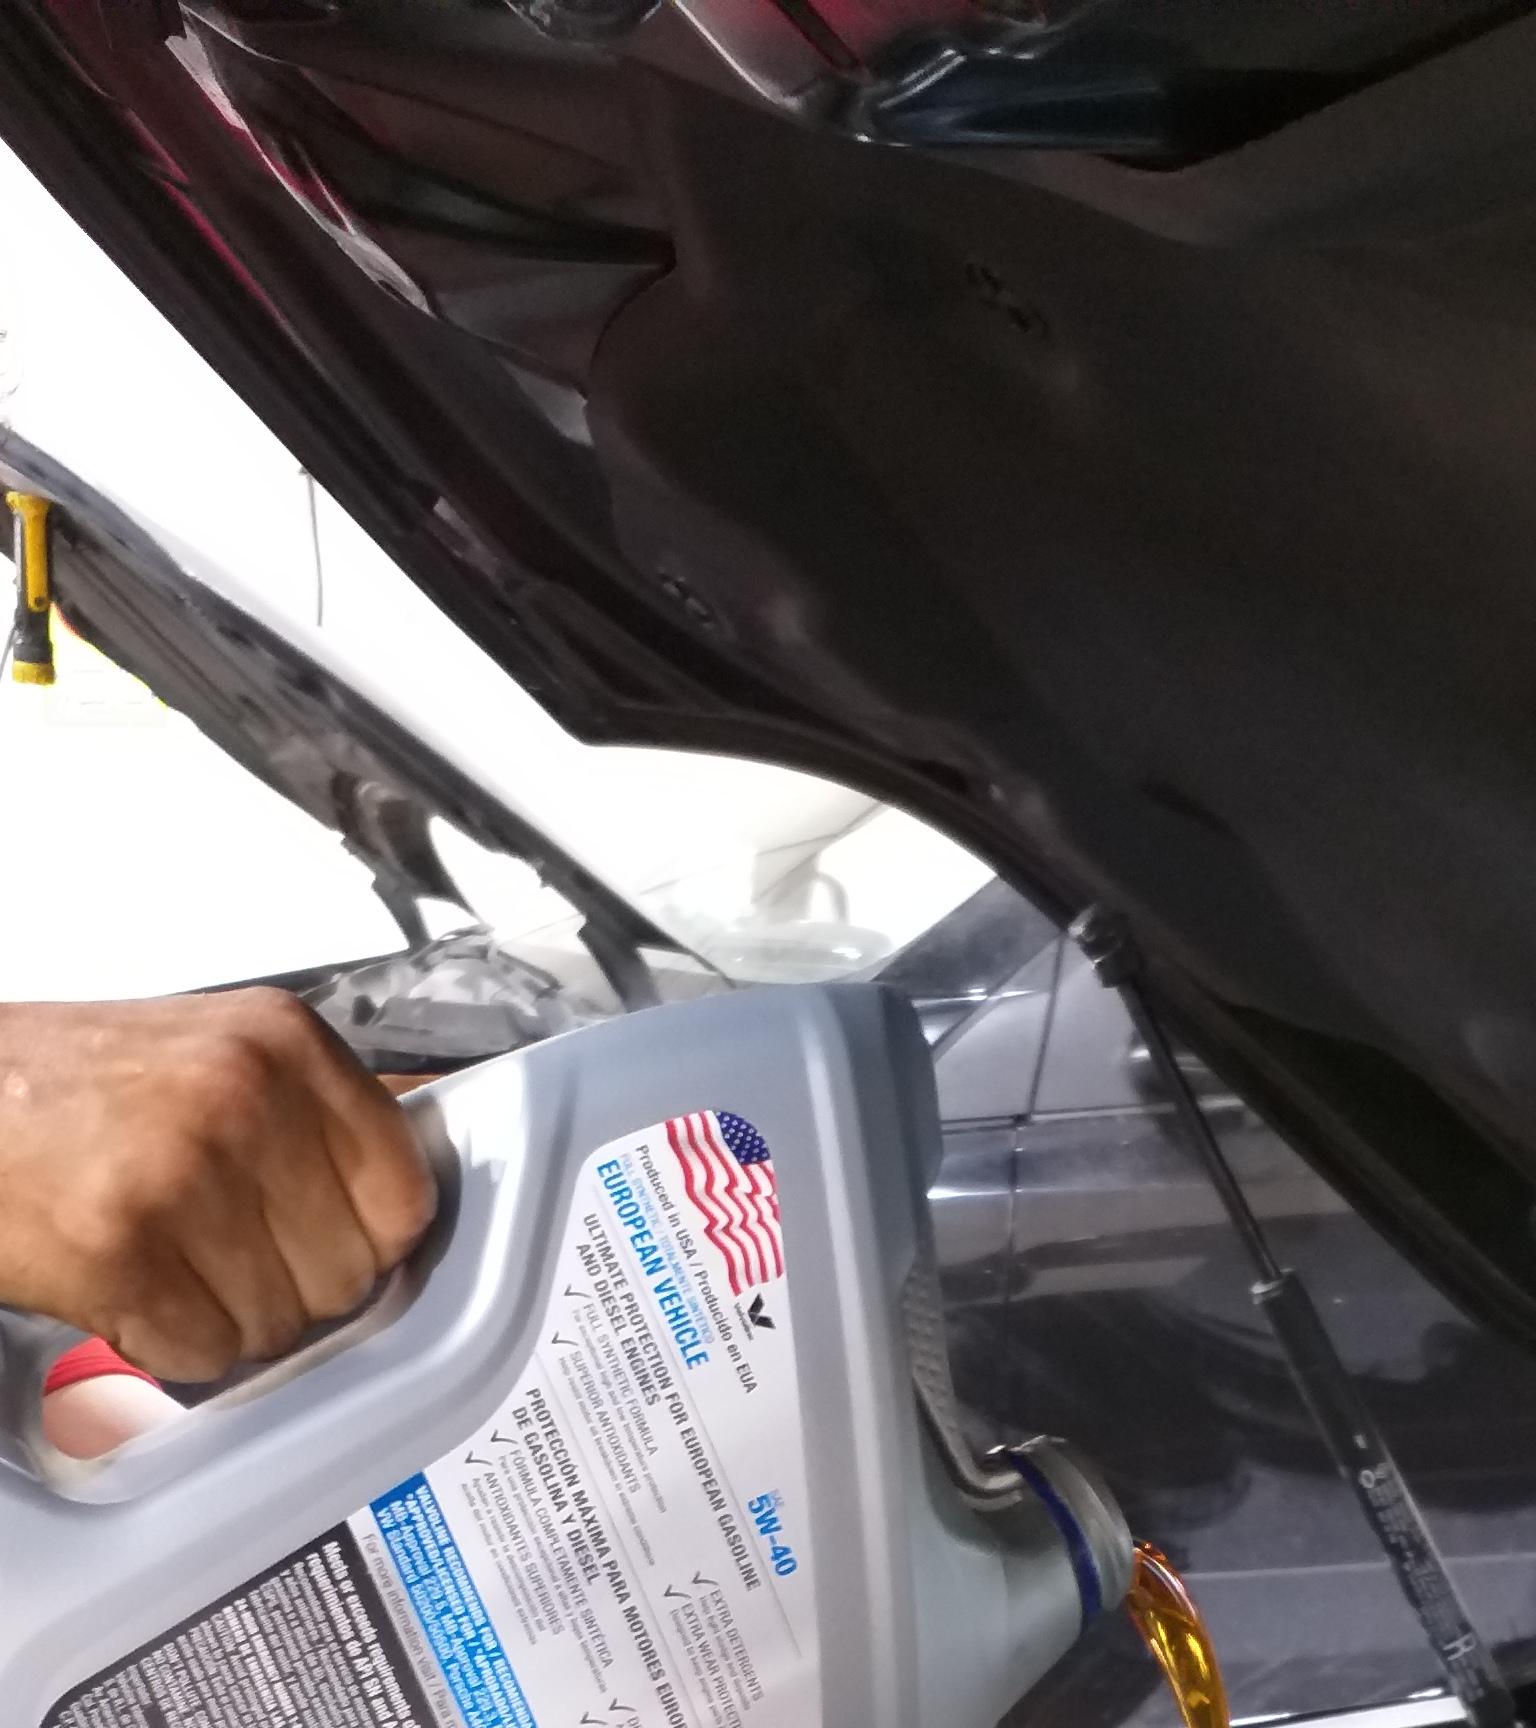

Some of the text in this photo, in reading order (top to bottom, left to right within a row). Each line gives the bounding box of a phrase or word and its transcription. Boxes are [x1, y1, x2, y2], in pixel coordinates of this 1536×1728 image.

[595, 1158, 710, 1371] EUROPEAN VEHICLE
[635, 1144, 759, 1394] Produced in USA / Producido en EUA
[575, 1240, 661, 1407] AND DIESEL ENGINES
[568, 1349, 642, 1494] SUPERIOR ANTIOXIDANTS
[581, 1302, 659, 1456] FULL SYNTHETIC FORMULA
[582, 1211, 762, 1591] ULTIMATE PROTECTION FOR EUROPEAN GASOLINE
[511, 1405, 602, 1585] DE GASOLINA Y DIESEL
[525, 1385, 584, 1488] PROTECCIÓN
[570, 1487, 616, 1559] MÁXIMA
[601, 1559, 632, 1604] PARA
[621, 1604, 666, 1682] MOTORES
[744, 1492, 801, 1579] 5W-40
[304, 1550, 357, 1641] requerimientos
[321, 1539, 352, 1581] Meets
[337, 1577, 358, 1595] or
[414, 1484, 451, 1547] VALVOLINE
[441, 1545, 487, 1627] RECOMMENDS
[477, 1625, 497, 1651] FOR
[508, 1446, 618, 1668] FÓRMULA COMPLETAMENTE SINTÉTICA
[523, 1561, 565, 1636] SUPERIORES
[344, 1592, 380, 1644] exceeds
[344, 1638, 365, 1658] de
[361, 1532, 381, 1556] For
[371, 1555, 396, 1589] more
[386, 1588, 427, 1657] information
[415, 1655, 438, 1682] visit
[430, 1688, 454, 1719] Para
[375, 1507, 395, 1530] VW
[385, 1528, 419, 1584] Standard
[445, 1661, 476, 1711] Porsche
[456, 1615, 476, 1641] FOR
[678, 1602, 706, 1642] EXTRA
[694, 1640, 720, 1678] WEAR
[708, 1588, 765, 1702] EXTRA DETERGENTS
[351, 1655, 375, 1680] API
[361, 1676, 383, 1698] SN
[365, 1639, 414, 1720] requirements
[369, 1694, 394, 1722] and
